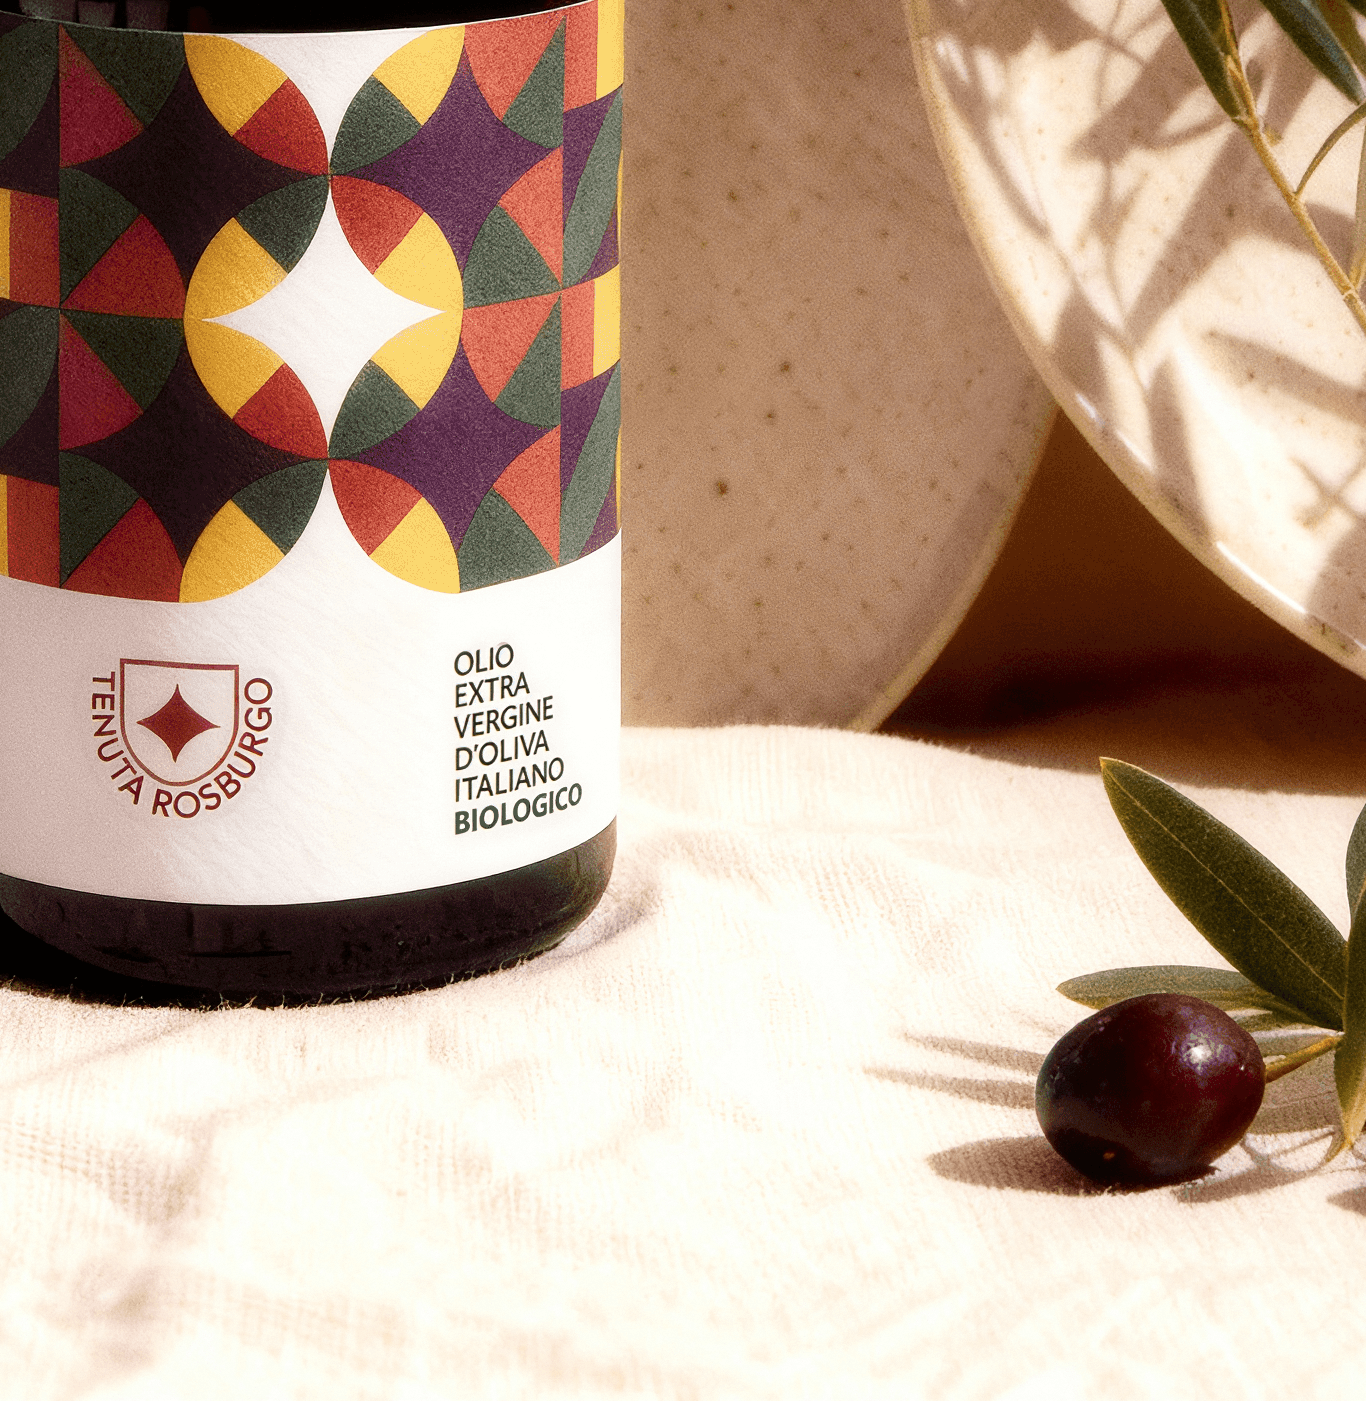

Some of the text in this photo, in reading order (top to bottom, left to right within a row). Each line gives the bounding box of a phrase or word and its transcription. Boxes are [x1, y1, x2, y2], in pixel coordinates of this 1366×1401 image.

[453, 642, 515, 677] OLIO
[454, 671, 531, 709] EXTRA
[453, 695, 554, 740] VERGINE
[91, 671, 275, 819] TENUTA ROSBURGO
[454, 729, 550, 772] D'OLIVA
[454, 756, 565, 803] ITALIANO
[453, 782, 583, 836] BIOLOGICO
